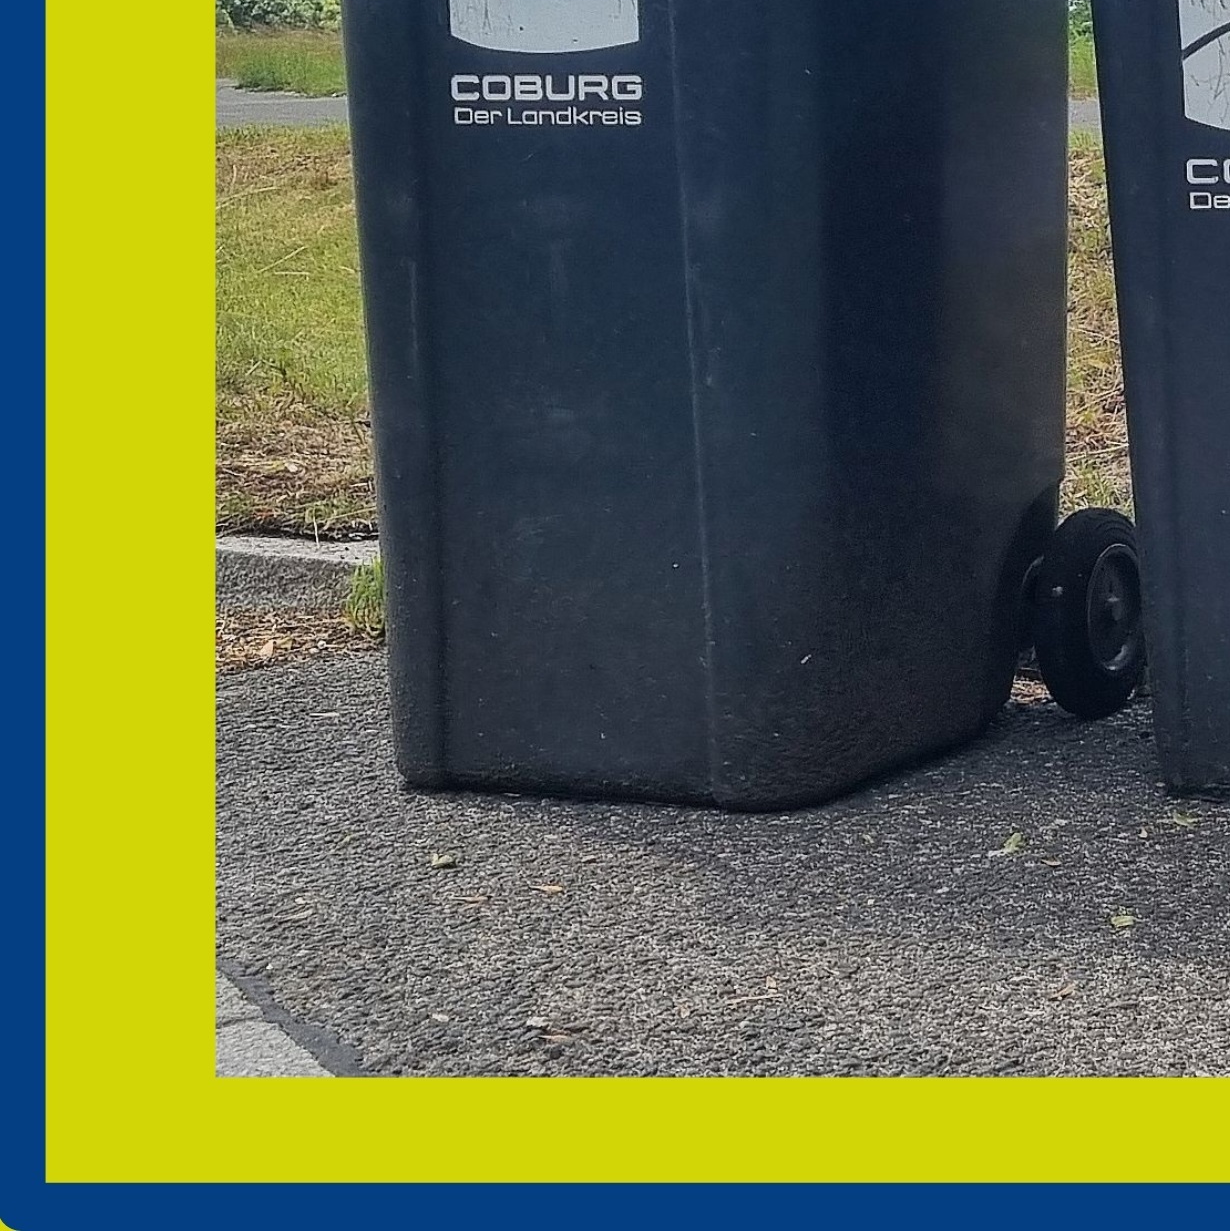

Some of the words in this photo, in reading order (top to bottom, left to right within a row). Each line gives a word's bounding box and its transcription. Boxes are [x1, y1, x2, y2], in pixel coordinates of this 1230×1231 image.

[451, 75, 643, 101] COBURG
[454, 107, 502, 125] Der
[508, 106, 642, 125] Landkreis
